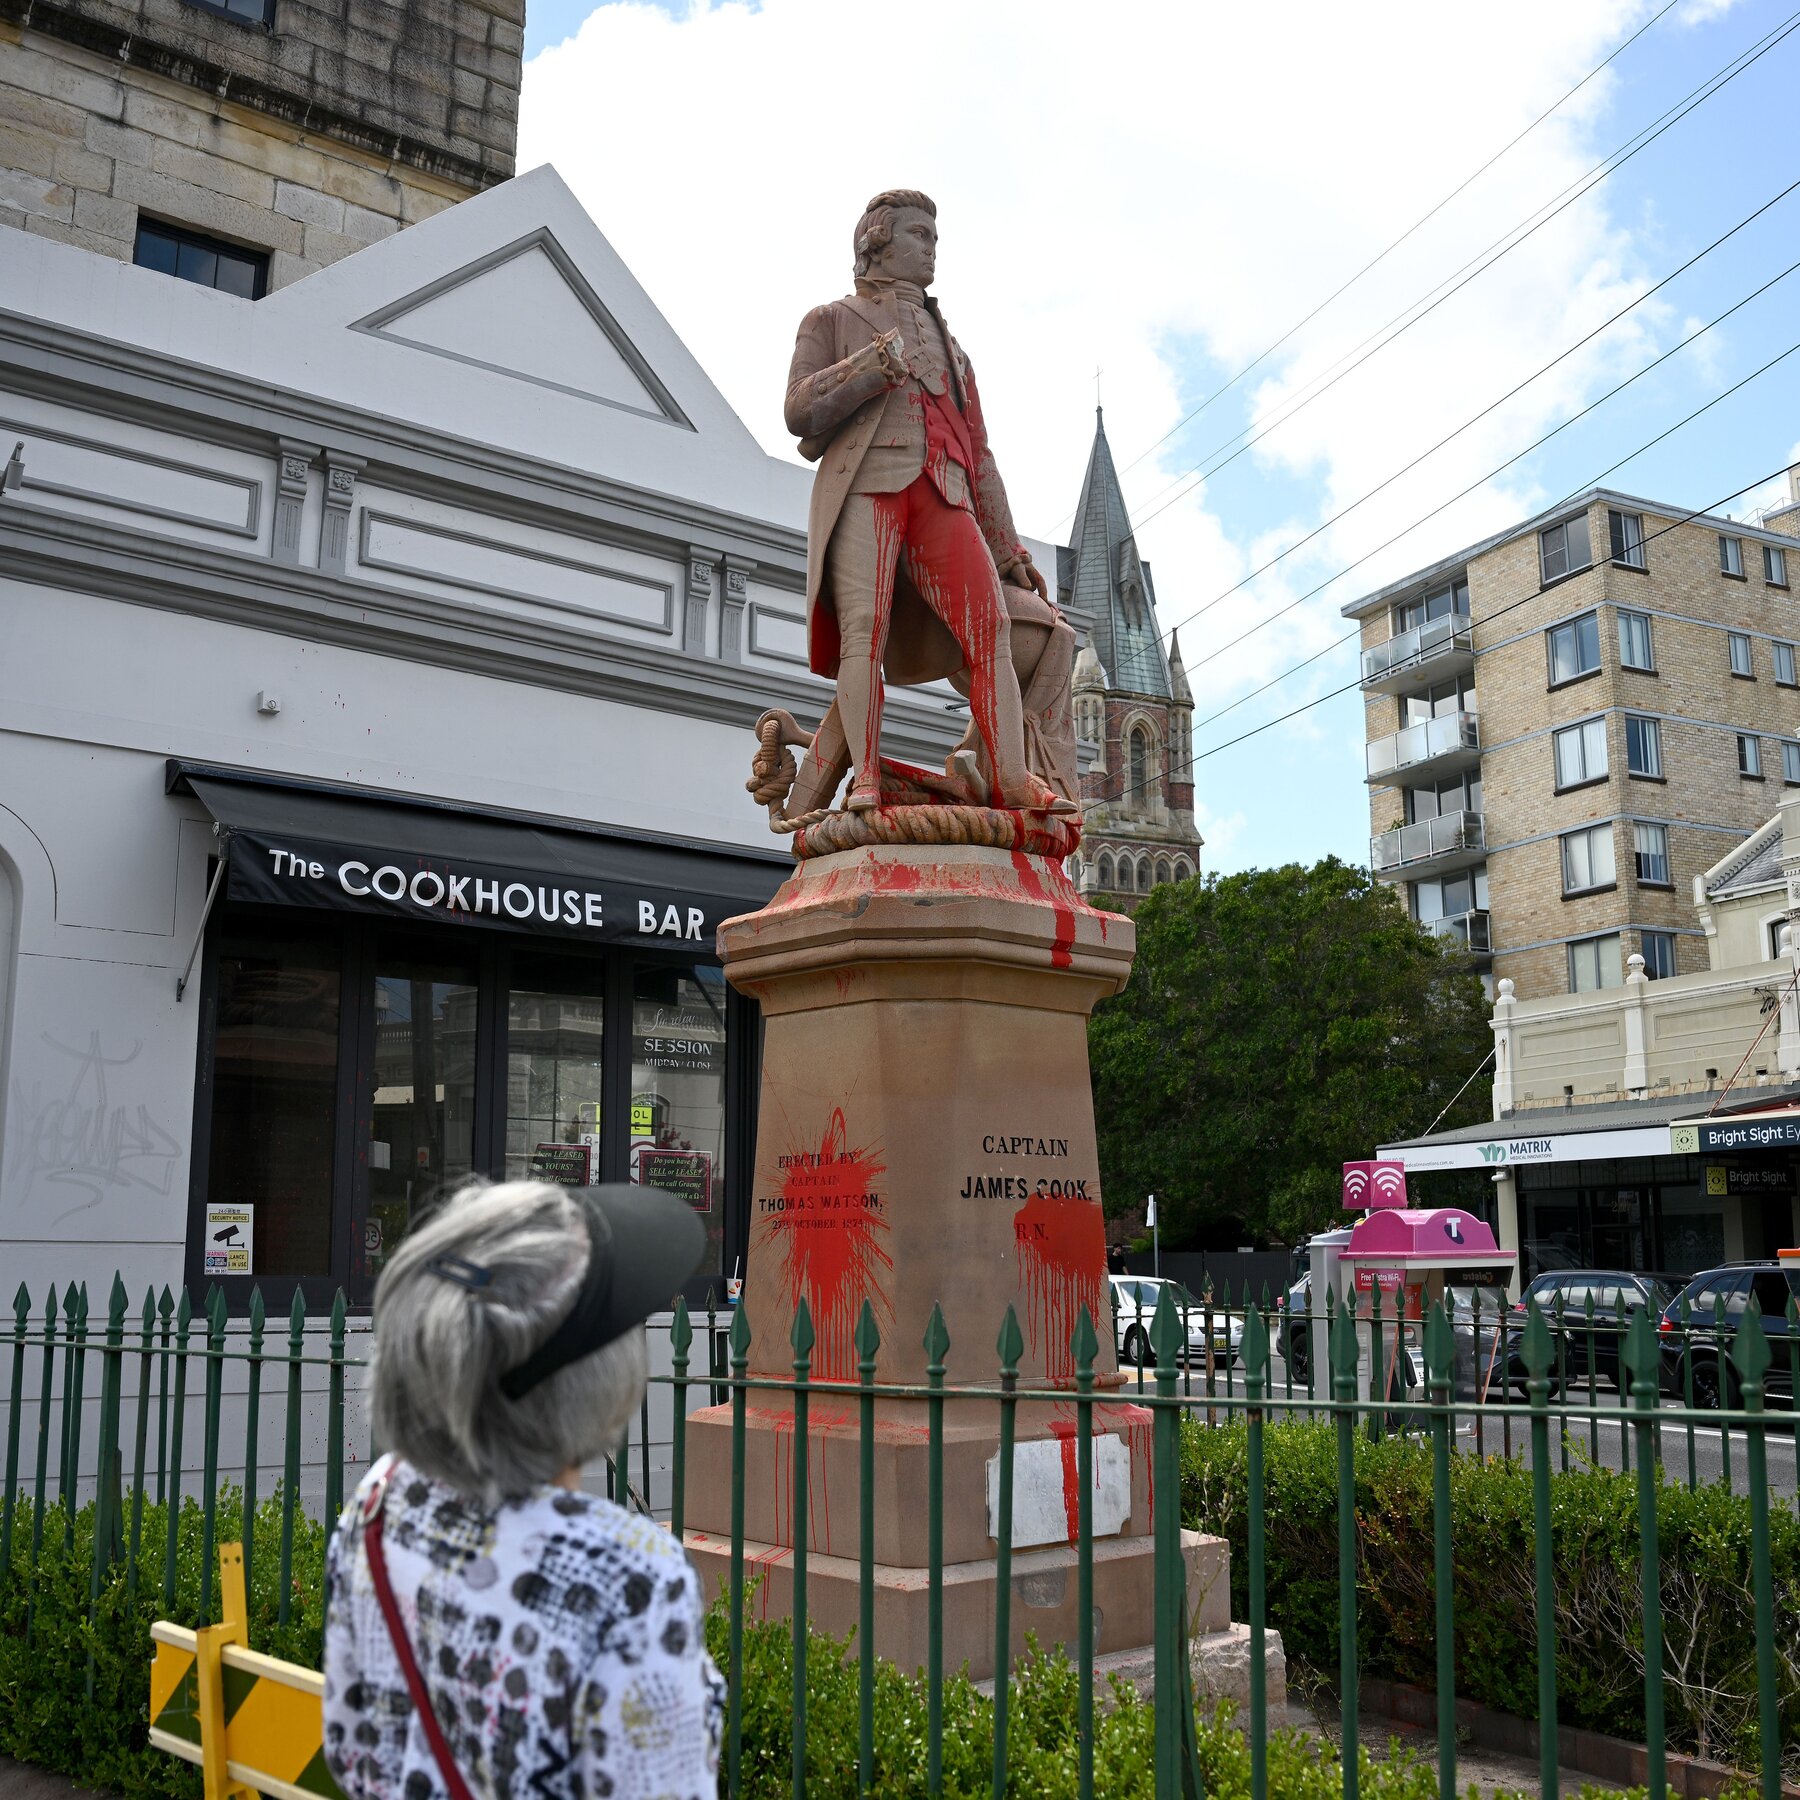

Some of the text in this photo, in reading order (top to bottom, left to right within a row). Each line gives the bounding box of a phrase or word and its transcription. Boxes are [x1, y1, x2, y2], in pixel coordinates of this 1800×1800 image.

[268, 849, 705, 941] The COOKHOUSE BAR
[643, 1038, 713, 1056] SESSION
[1708, 1129, 1747, 1147] Bright
[1749, 1126, 1783, 1144] Sight
[982, 1135, 1069, 1157] CAPTAIN
[1510, 1140, 1552, 1155] MATRIX
[778, 1151, 858, 1169] ERECTED BY
[791, 1175, 840, 1187] CAPTAIN
[1729, 1170, 1787, 1185] Bright Sight
[960, 1176, 1092, 1201] JAMES COOK.
[759, 1194, 883, 1212] THOMAS WATSON,
[794, 1219, 836, 1230] OCTOBER
[1446, 1217, 1461, 1237] T
[1360, 1273, 1371, 1281] Free
